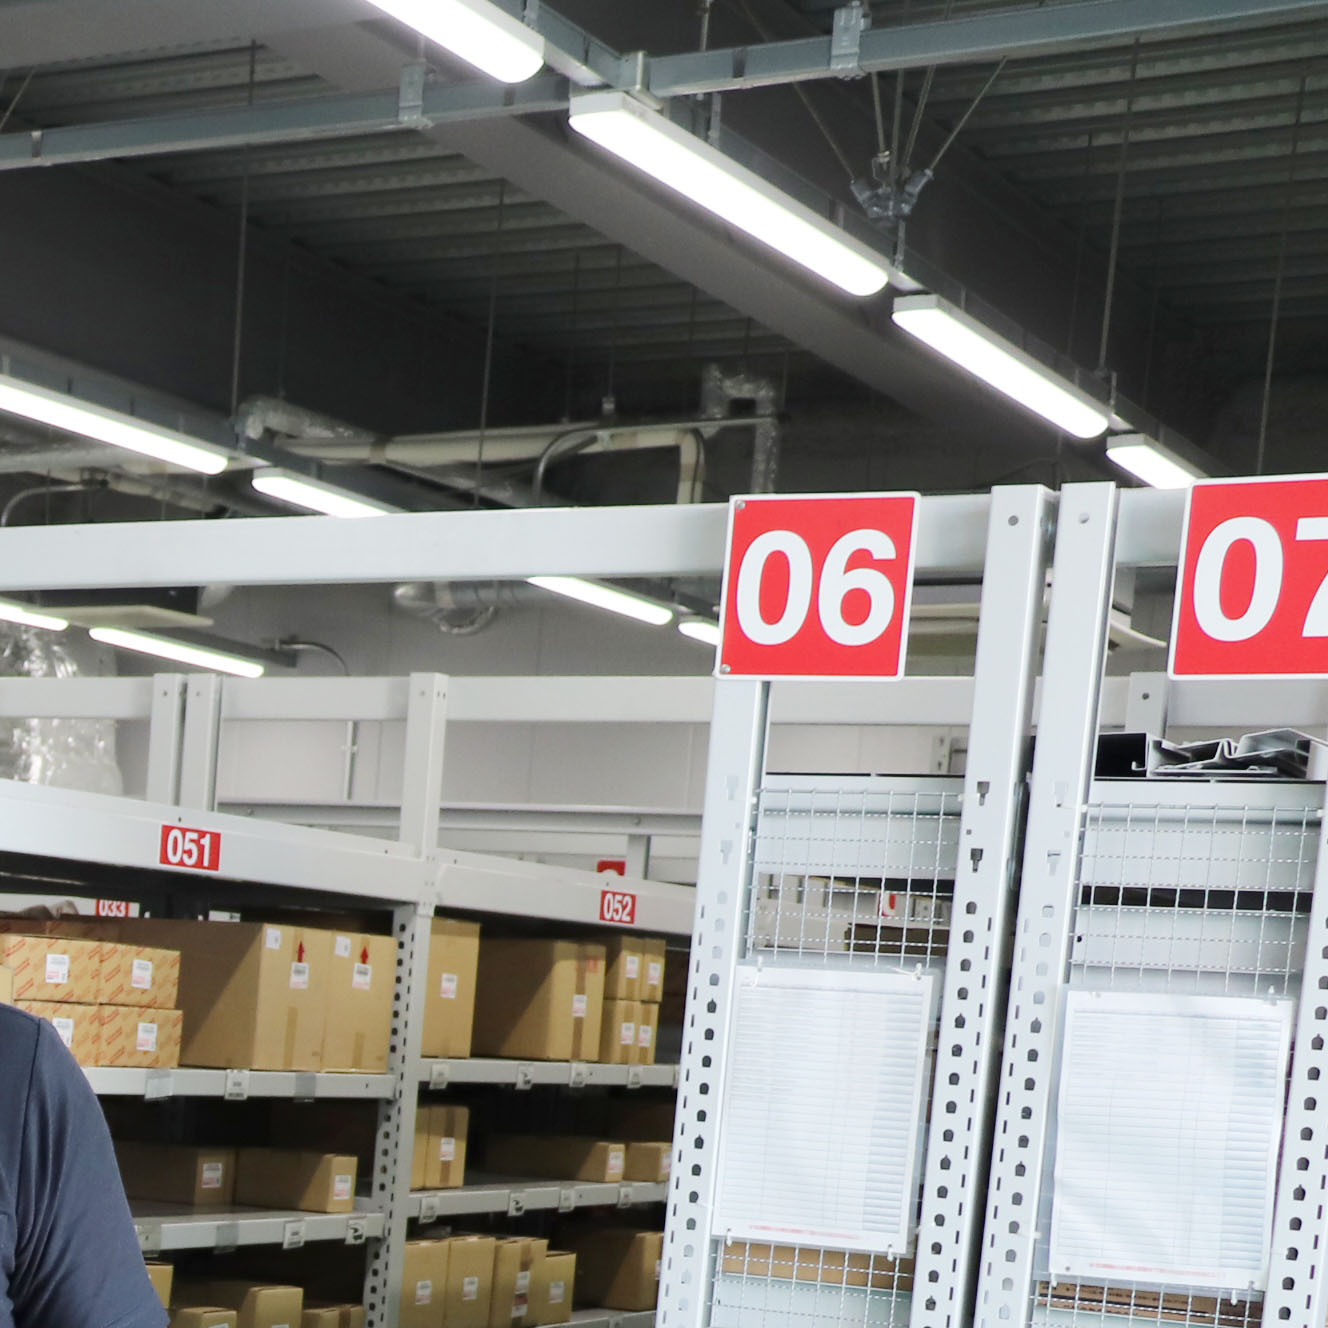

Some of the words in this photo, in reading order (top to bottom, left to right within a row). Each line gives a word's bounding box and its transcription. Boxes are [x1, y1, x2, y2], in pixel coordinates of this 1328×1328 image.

[736, 528, 897, 647] 06
[166, 828, 211, 868] 051
[603, 892, 633, 922] 052
